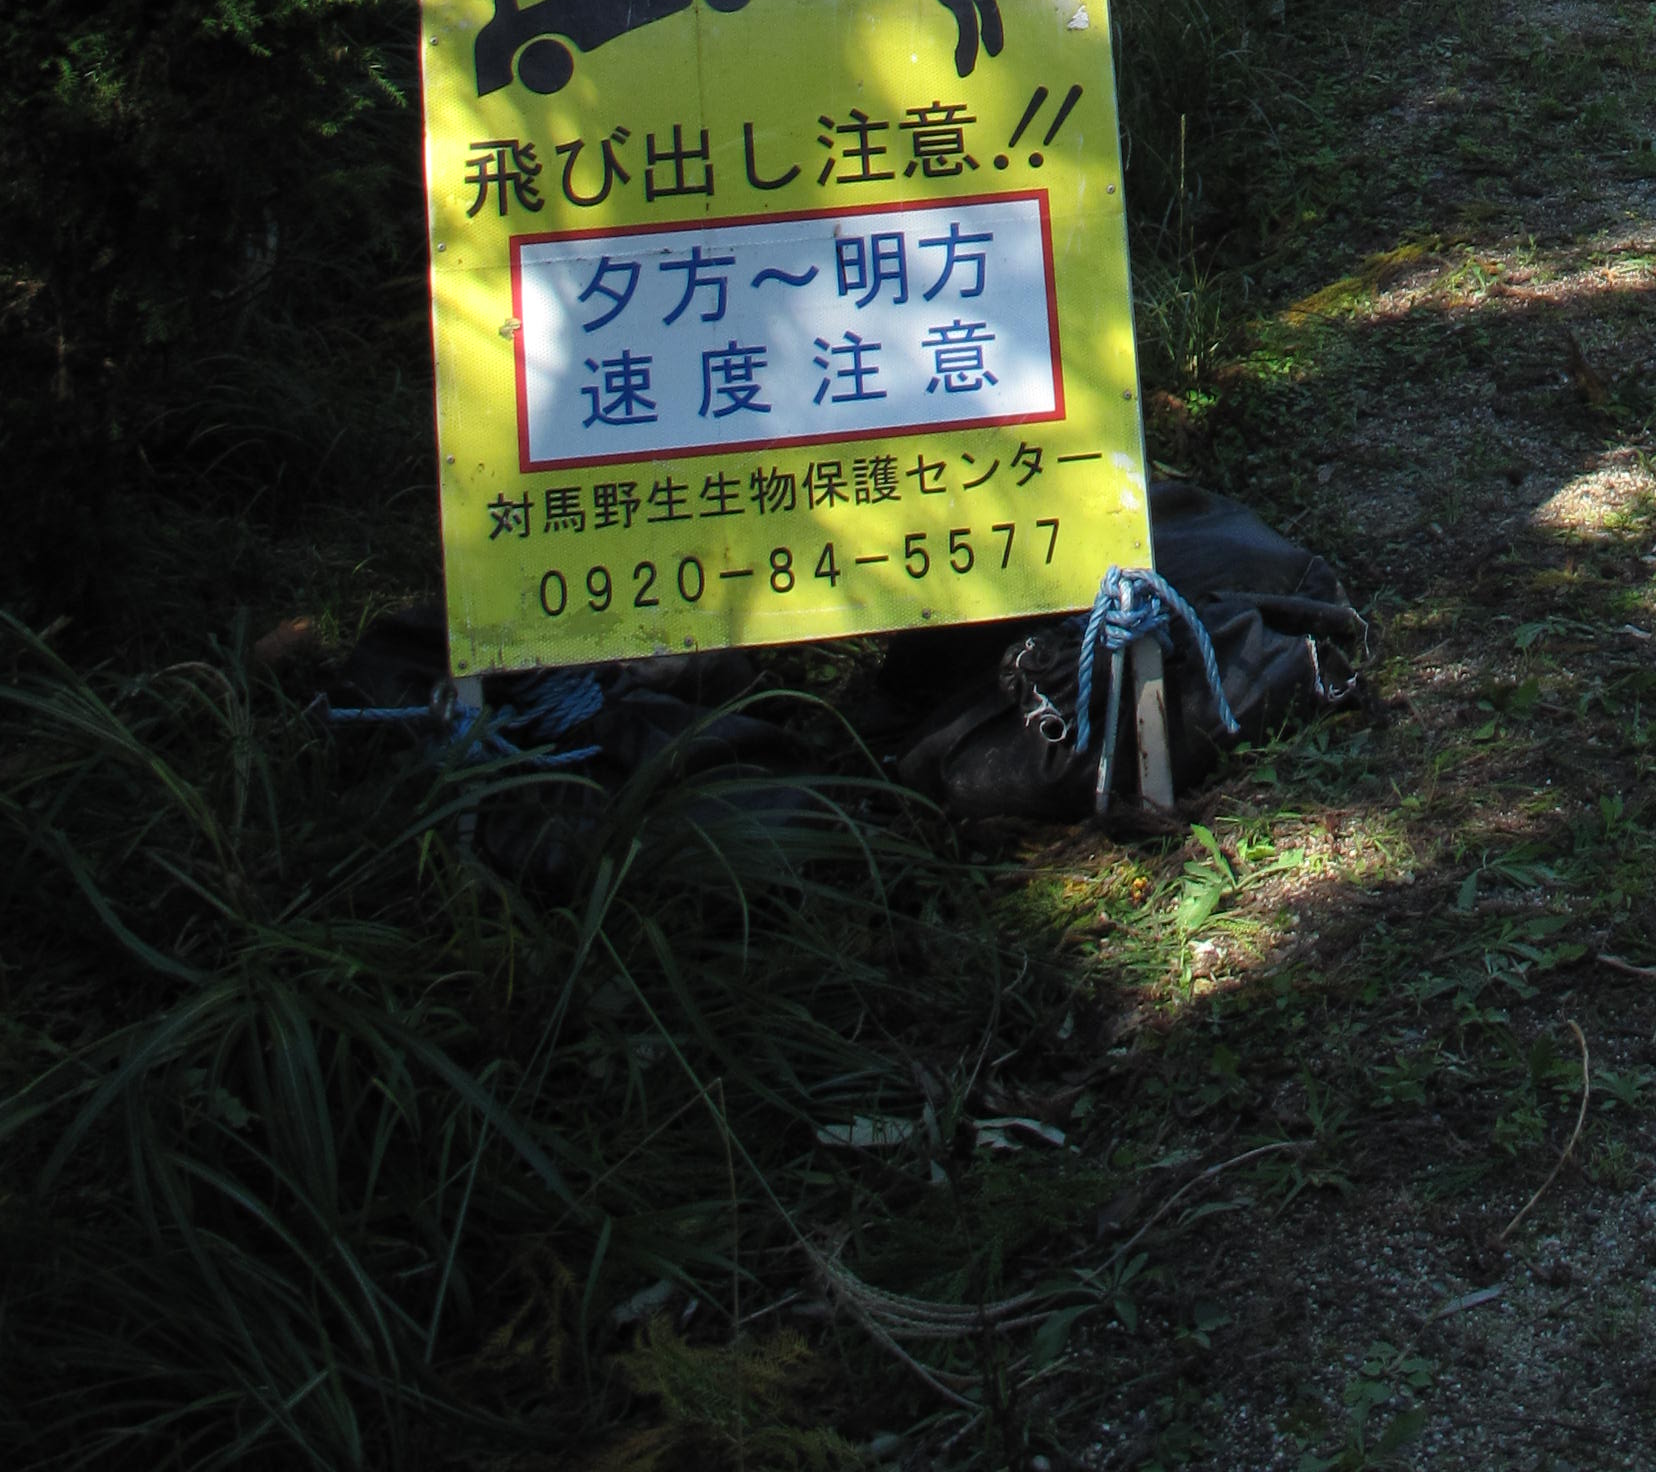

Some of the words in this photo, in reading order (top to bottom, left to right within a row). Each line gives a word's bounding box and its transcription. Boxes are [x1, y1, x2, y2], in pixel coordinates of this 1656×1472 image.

[464, 84, 1084, 219] 飛び出し注意!!
[580, 318, 1001, 430] 速度注意
[487, 440, 1104, 542] 対馬野生生物保護センター
[538, 518, 1061, 617] 0920-84-5577
